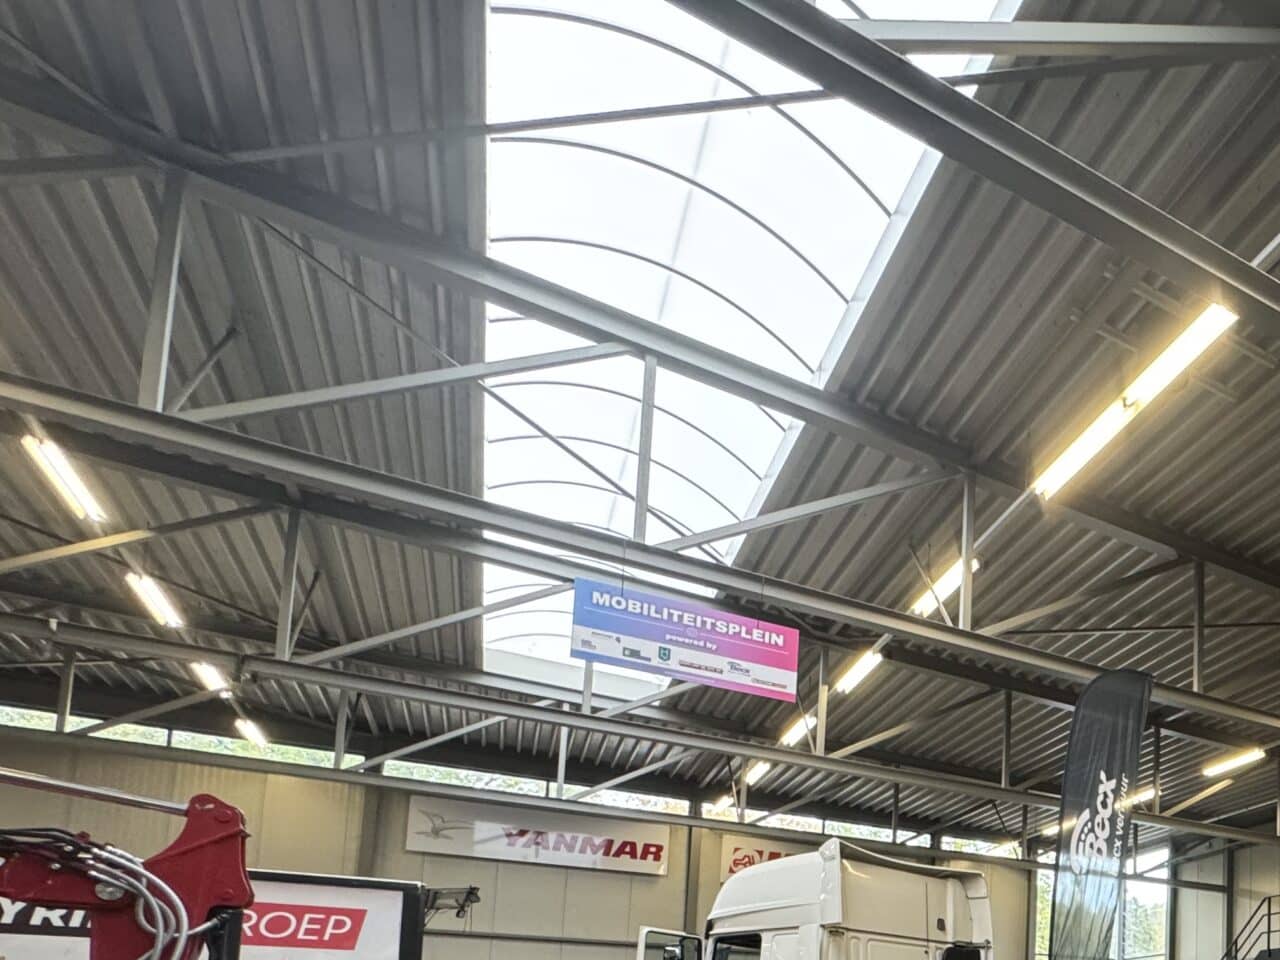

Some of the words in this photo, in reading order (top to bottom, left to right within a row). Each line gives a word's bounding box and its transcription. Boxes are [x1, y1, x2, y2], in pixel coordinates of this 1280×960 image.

[592, 591, 785, 647] MOBILITEITSPLEIN
[665, 633, 704, 648] powered
[705, 641, 718, 651] by
[1084, 770, 1118, 860] Becx
[502, 826, 665, 863] YANMAR
